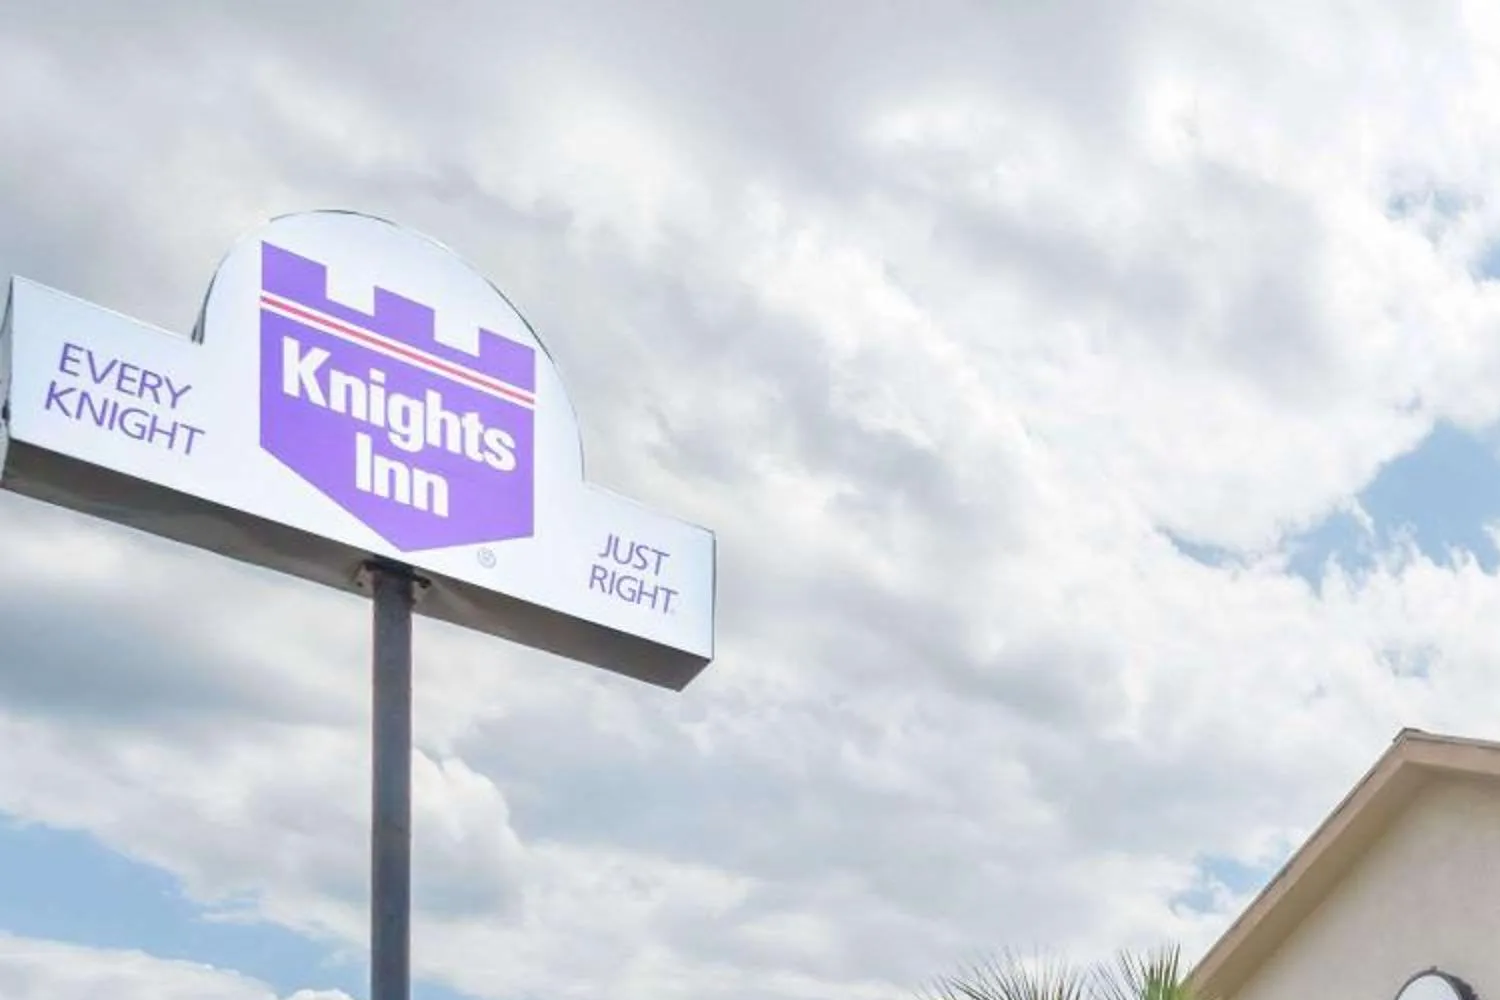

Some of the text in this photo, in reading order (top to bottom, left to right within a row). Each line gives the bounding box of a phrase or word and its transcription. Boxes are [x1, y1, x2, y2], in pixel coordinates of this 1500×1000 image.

[59, 341, 193, 410] EVERY
[282, 335, 517, 472] Knights
[44, 381, 207, 456] KNIGHT
[354, 432, 450, 518] Inn
[588, 563, 680, 614] RIGHT
[598, 533, 670, 576] JUST
